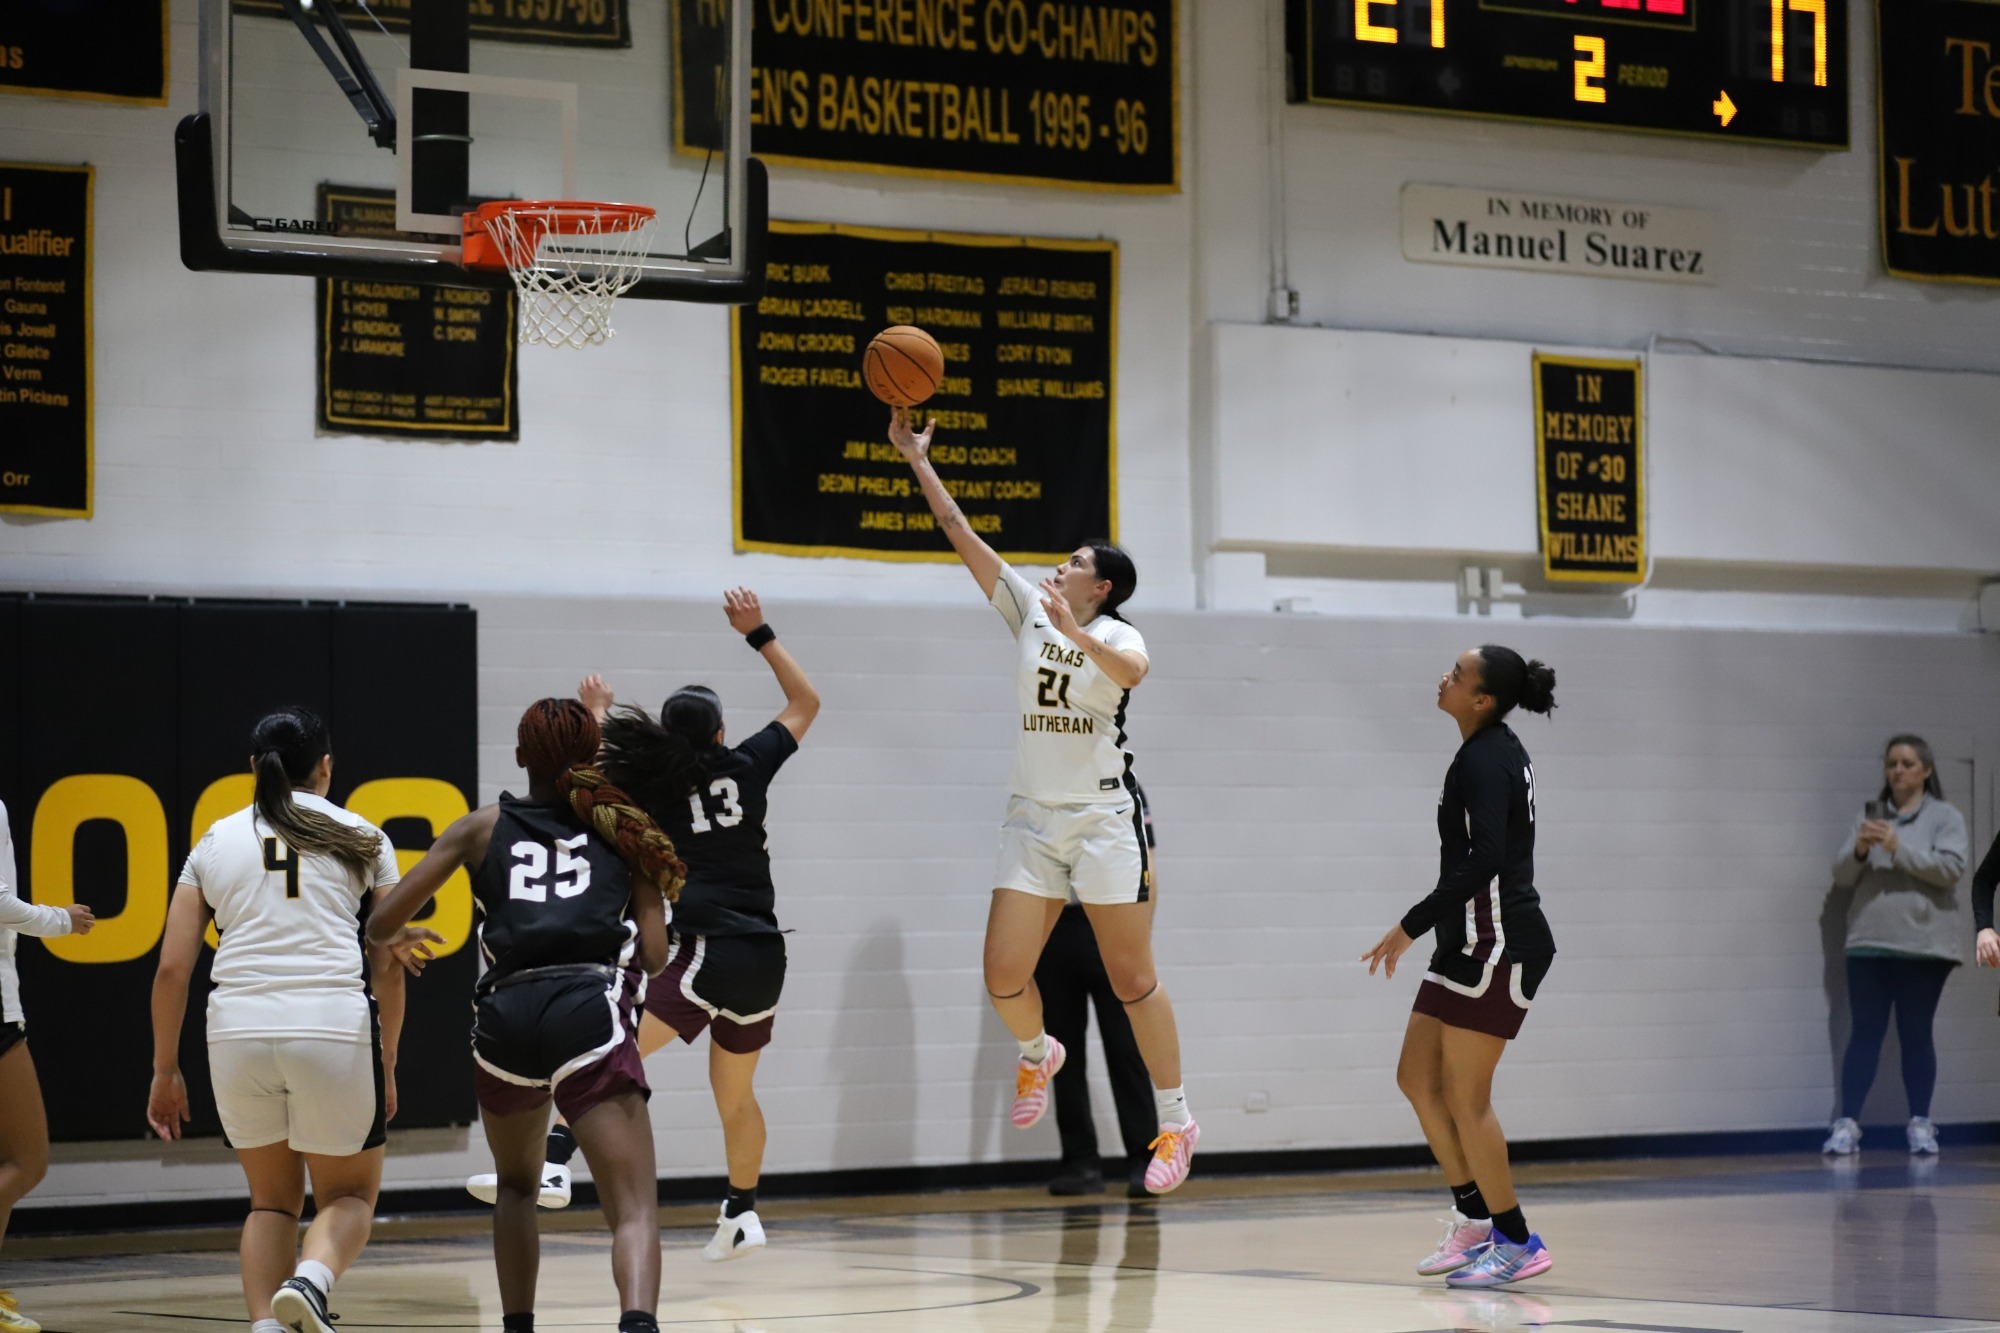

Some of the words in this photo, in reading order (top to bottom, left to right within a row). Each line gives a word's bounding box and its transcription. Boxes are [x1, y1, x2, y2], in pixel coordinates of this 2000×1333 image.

[769, 0, 977, 50] CONFERENCE
[985, 0, 1158, 66] CO-CHAMPS
[1573, 35, 1606, 103] 2
[1618, 64, 1669, 88] PERIOD
[818, 73, 1019, 144] BASKETBALL
[1029, 89, 1091, 150] 1995
[1115, 98, 1148, 154] 96
[275, 218, 338, 232] GARED
[1487, 197, 1510, 215] IN
[1520, 200, 1613, 226] MEMORY
[1622, 210, 1650, 229] OF
[0, 229, 74, 257] ualifier
[1433, 219, 1567, 262] Manuel
[1585, 231, 1703, 275] Suarez
[766, 262, 790, 282] RIC
[792, 264, 831, 284] BURK
[885, 271, 926, 291] CHRIS
[447, 308, 480, 323] SMITH
[757, 296, 800, 316] BRIAN
[887, 306, 914, 325] NED
[997, 311, 1051, 329] WILLIAM
[1053, 314, 1094, 332] SMITH
[757, 331, 796, 351] JOHN
[797, 333, 855, 354] CROOKS
[997, 344, 1034, 363] CORY
[760, 365, 808, 386] ROGER
[810, 367, 862, 388] FAVELA
[935, 376, 972, 396] EWIS
[997, 378, 1041, 397] SHANE
[1042, 380, 1105, 399] WILLIAMS
[1576, 374, 1601, 403] IN
[1546, 412, 1632, 443] MEMORY
[842, 441, 867, 460] JIM
[930, 446, 968, 464] HEAD
[970, 447, 1016, 466] COACH
[1556, 451, 1583, 480] OF
[3, 471, 30, 486] Orr
[858, 475, 911, 497] PHELPS
[994, 481, 1041, 499] COACH
[1557, 492, 1626, 523] SHANE
[860, 511, 904, 530] JAMES
[1548, 531, 1641, 562] WILLIAMS
[1040, 642, 1085, 668] TEXAS
[1037, 667, 1072, 710] 21
[1023, 714, 1094, 734] LUTHERAN
[688, 776, 743, 834] 13
[263, 836, 301, 899] 4
[509, 833, 591, 902] 25
